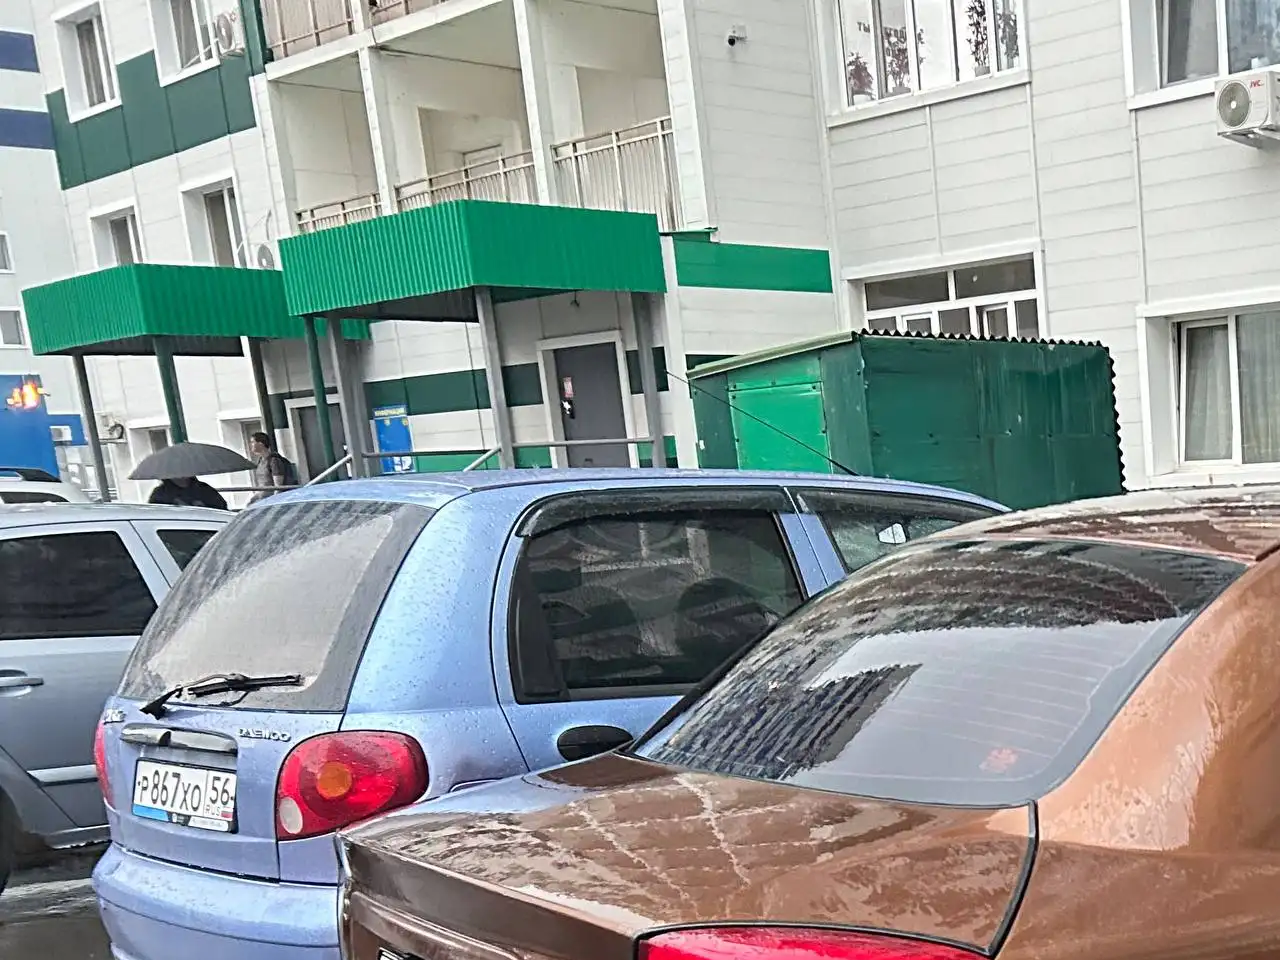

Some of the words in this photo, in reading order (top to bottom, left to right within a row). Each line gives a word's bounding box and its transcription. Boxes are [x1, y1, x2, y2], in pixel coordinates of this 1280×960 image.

[238, 728, 292, 742] DAEWOO
[208, 776, 230, 806] 56
[204, 805, 222, 817] RUS
